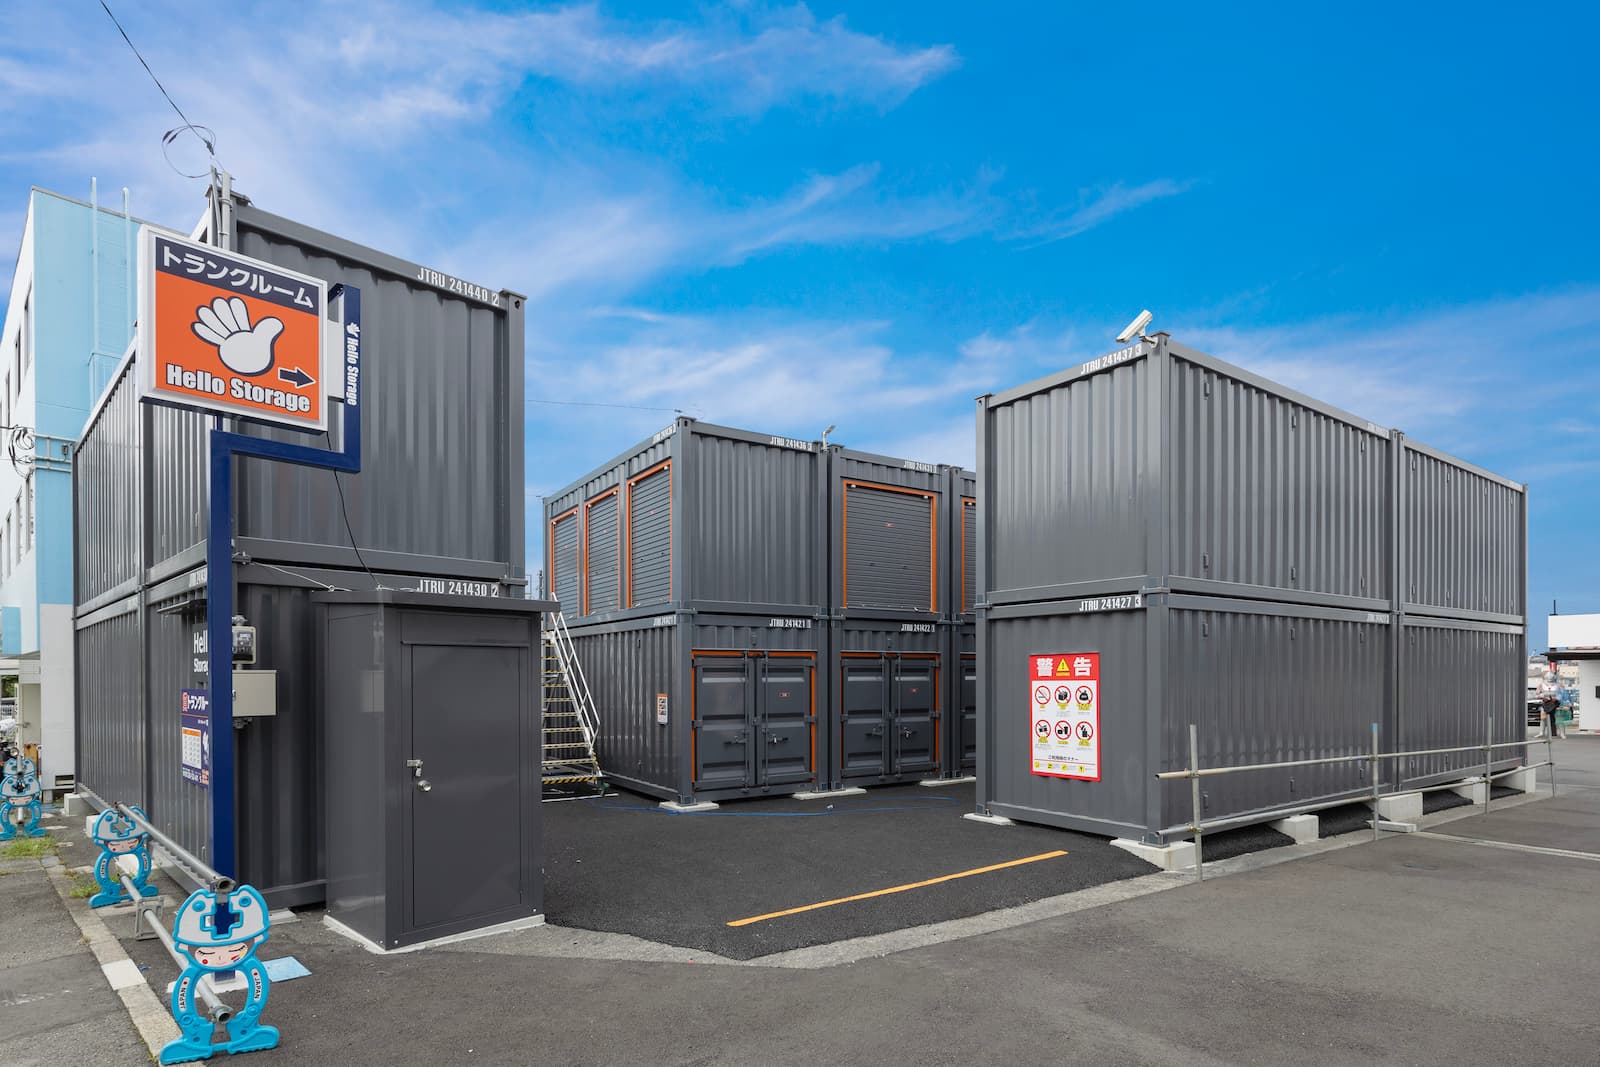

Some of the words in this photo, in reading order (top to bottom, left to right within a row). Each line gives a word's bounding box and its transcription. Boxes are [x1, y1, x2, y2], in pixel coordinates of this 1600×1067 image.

[164, 246, 313, 308] トランクルーム
[417, 267, 445, 288] JTRU
[449, 278, 488, 302] 241440
[347, 337, 358, 364] Hello
[1080, 358, 1101, 375] JTRU
[1102, 346, 1133, 367] 241437
[165, 363, 226, 395] Hello
[230, 377, 311, 413] Storage
[346, 366, 359, 406] Storage
[417, 579, 445, 594] JTRU
[448, 581, 487, 597] 241430
[1079, 600, 1099, 612] JTRU
[1101, 597, 1132, 610] 241427
[193, 629, 208, 654] Hell
[193, 658, 209, 676] Stora
[1073, 656, 1092, 677] 告
[187, 695, 209, 711] トランクルー
